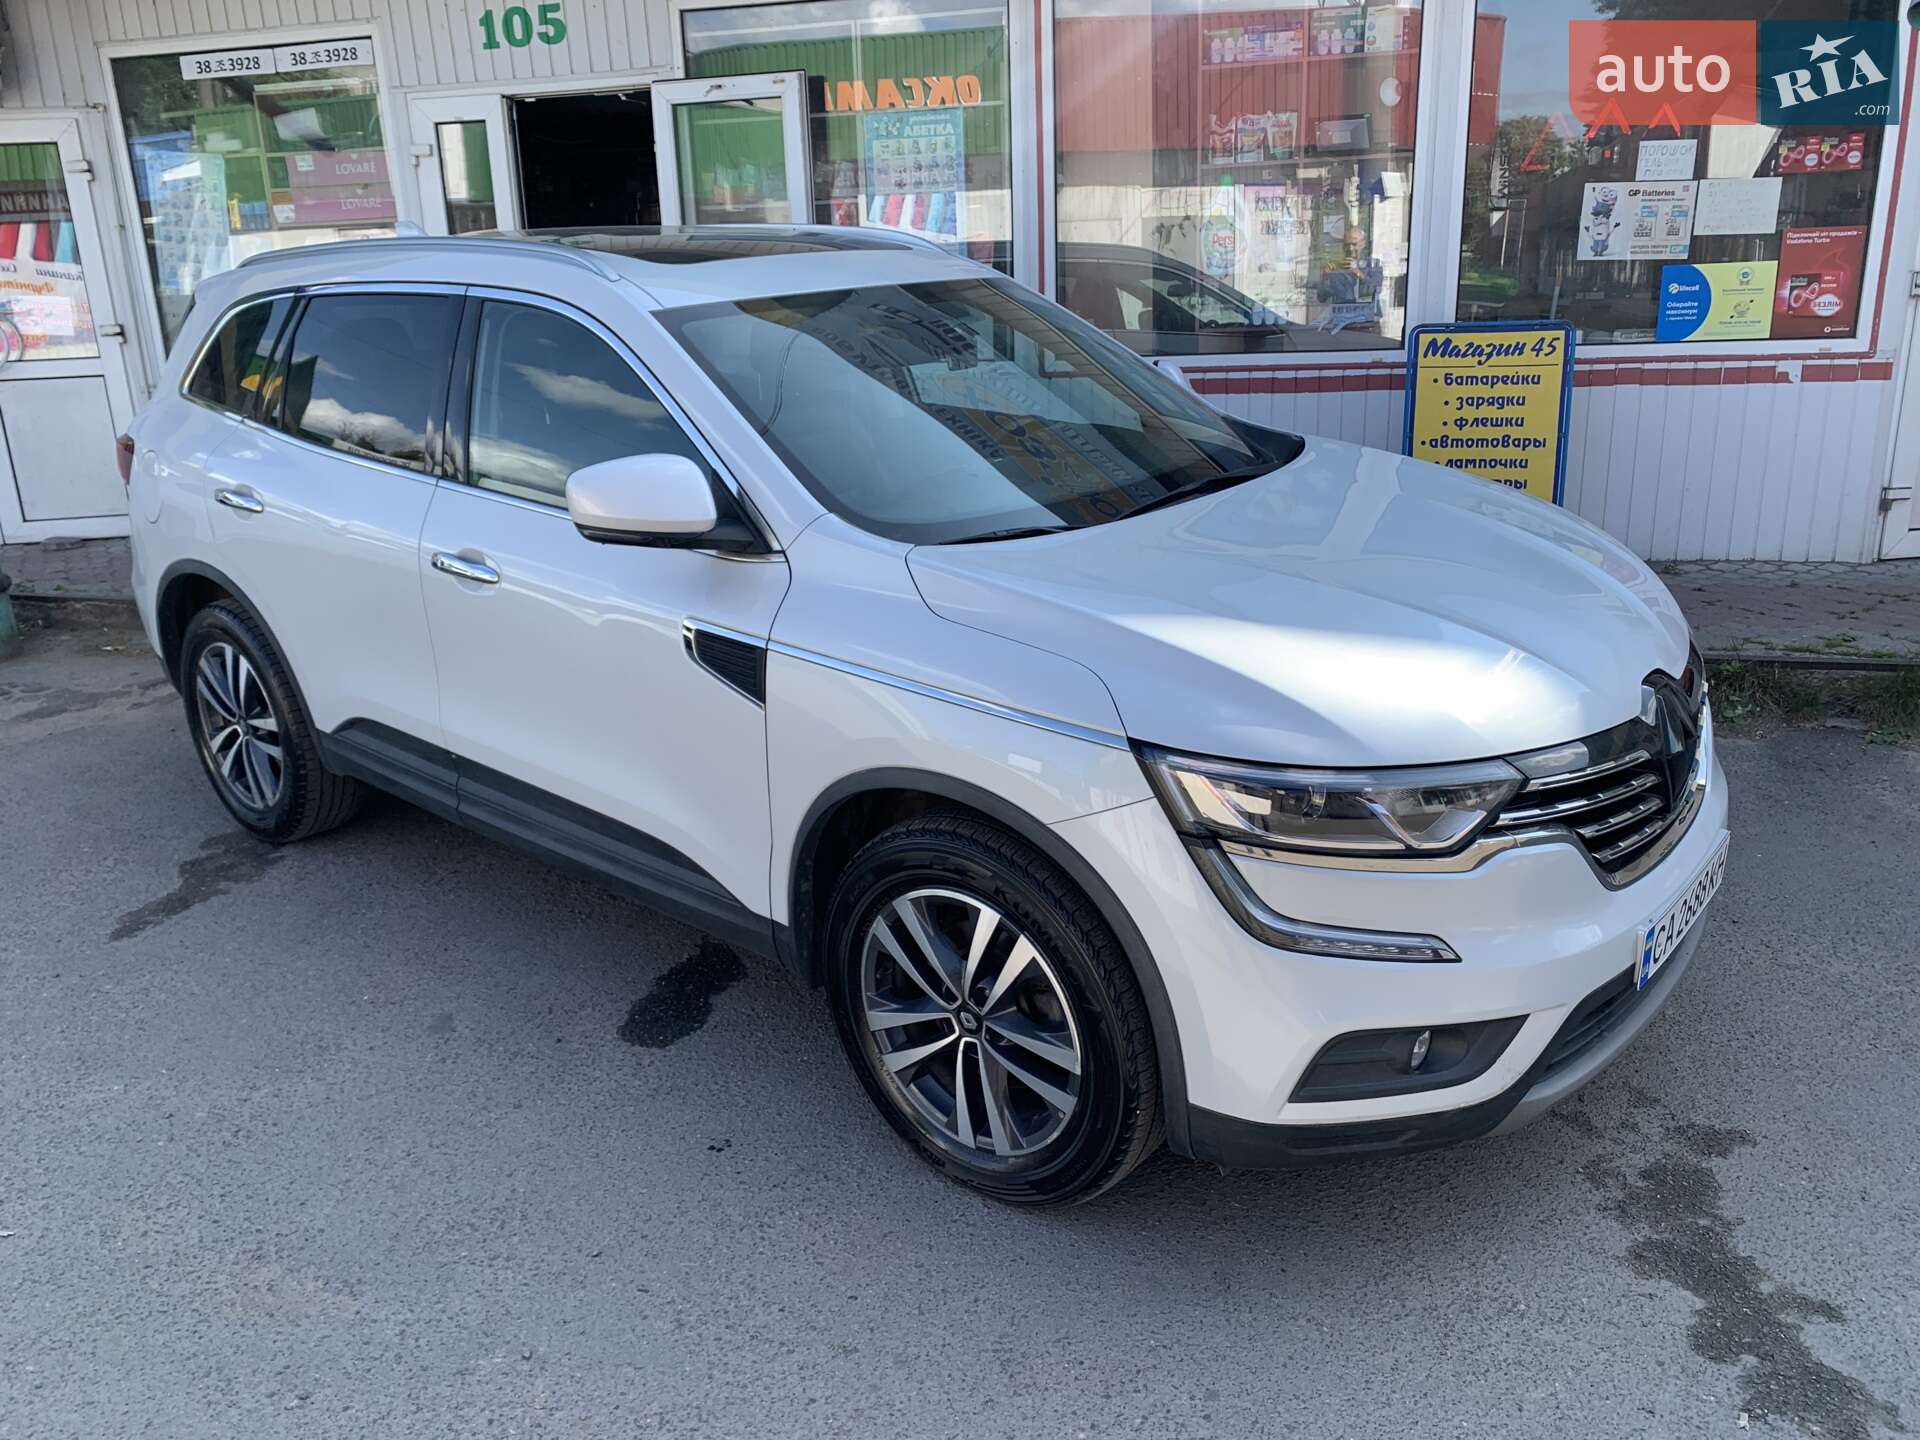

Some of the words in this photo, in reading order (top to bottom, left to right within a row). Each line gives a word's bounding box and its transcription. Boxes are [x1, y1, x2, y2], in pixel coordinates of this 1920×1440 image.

[479, 3, 567, 49] 105
[1628, 189, 1641, 197] GP
[1641, 189, 1676, 197] Batteries
[1423, 337, 1527, 366] Магазин
[1530, 337, 1560, 357] 45
[1456, 395, 1526, 410] зарядки
[1454, 415, 1525, 431] флешки
[1429, 435, 1547, 451] автотовары
[1445, 458, 1529, 469] лампочки
